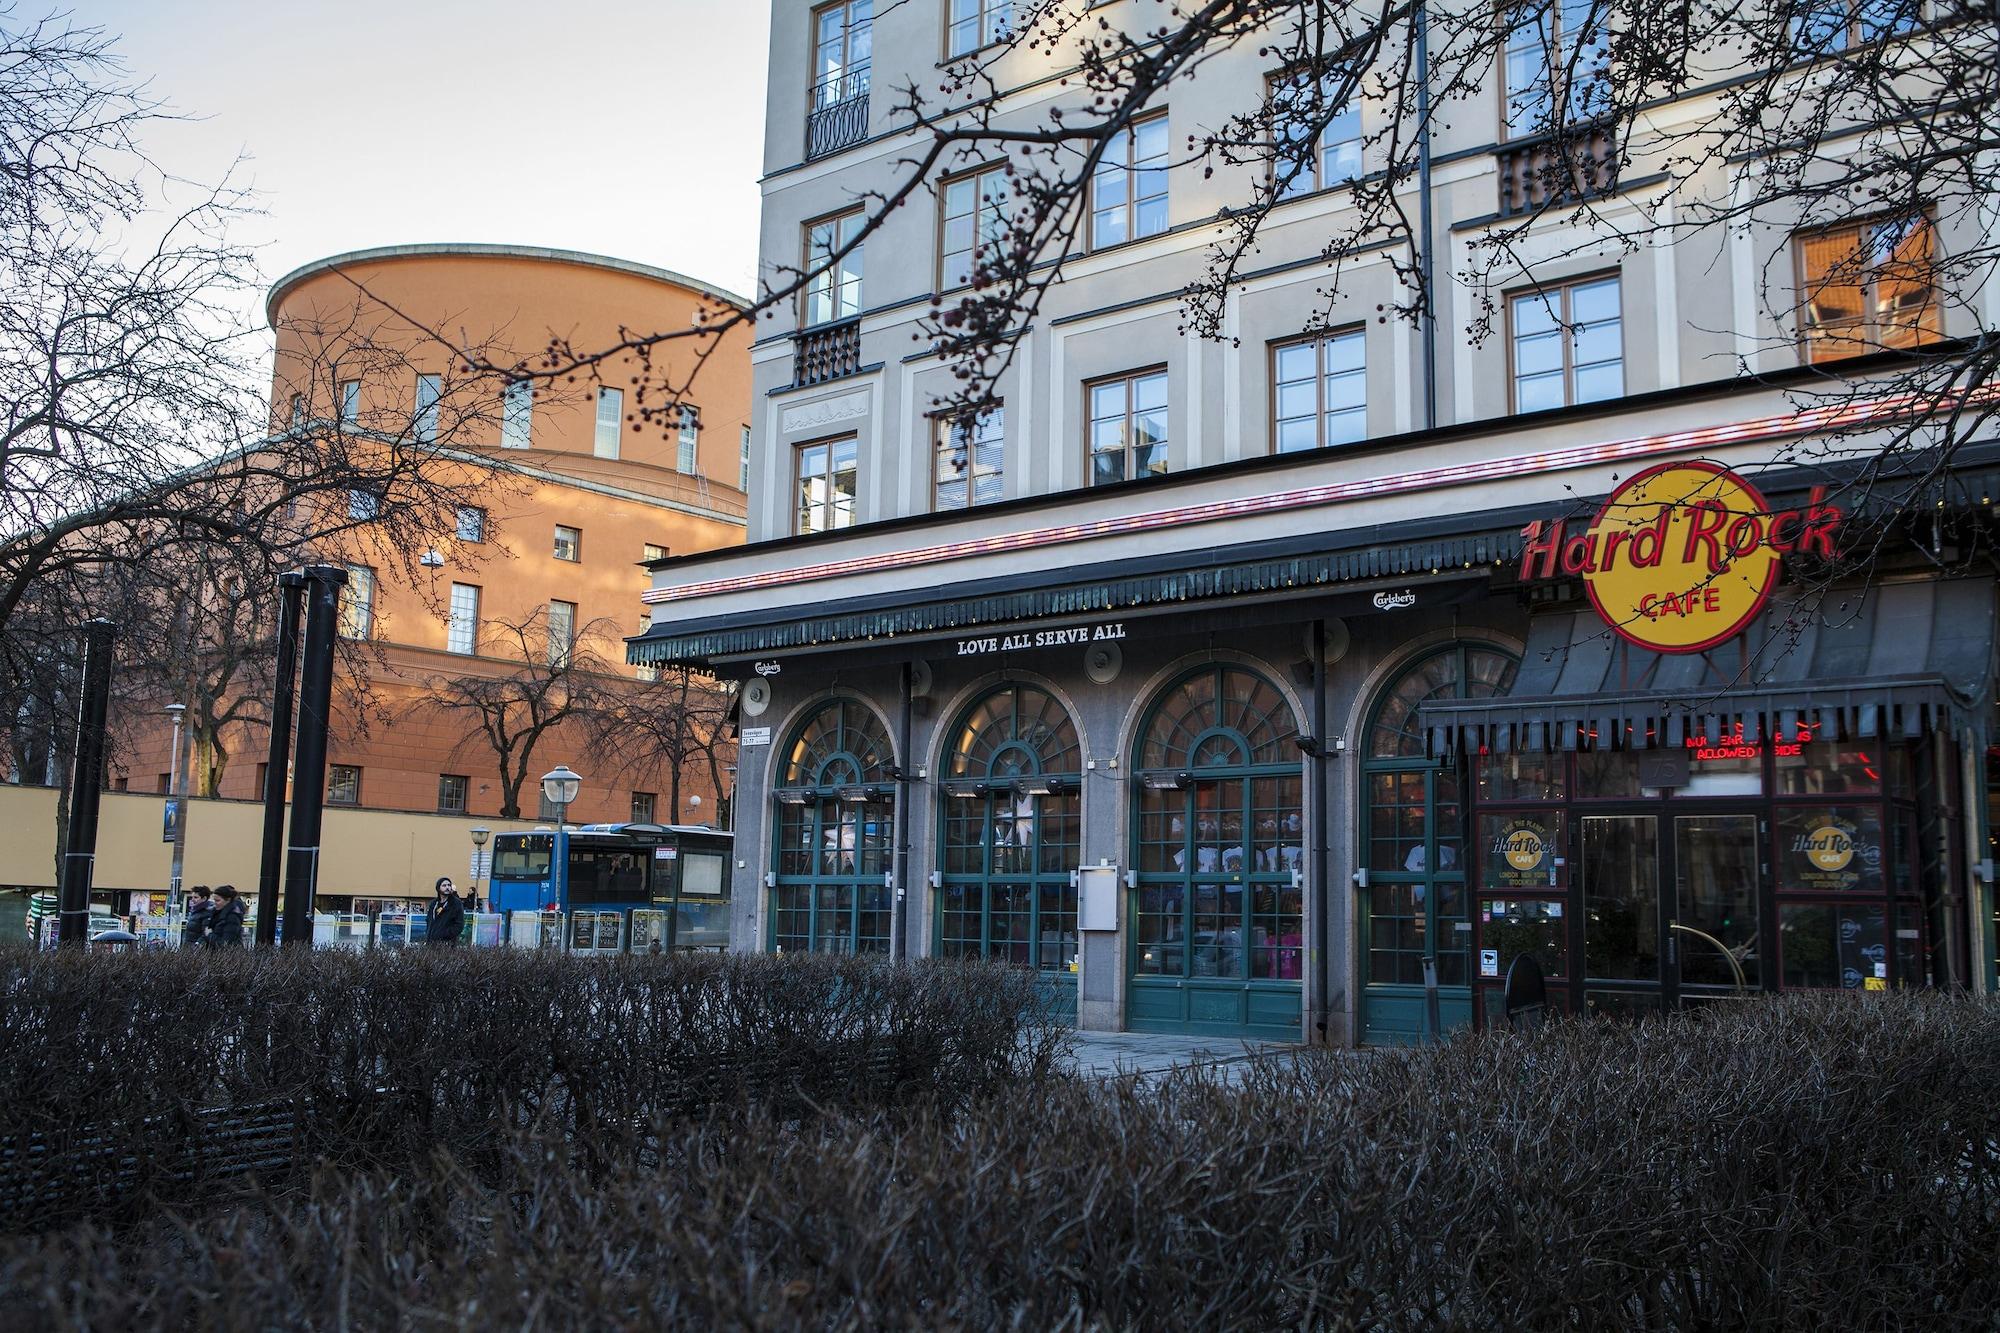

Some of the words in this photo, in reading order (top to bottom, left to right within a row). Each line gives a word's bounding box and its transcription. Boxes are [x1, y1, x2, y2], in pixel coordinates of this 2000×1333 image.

[1518, 504, 1672, 581] Hard
[1681, 485, 1845, 575] Rock
[1373, 590, 1416, 610] Carlsberg
[1639, 587, 1721, 617] CAFE
[957, 638, 998, 655] LOVE
[1001, 634, 1031, 650] ALL
[1035, 627, 1089, 646] SERVE
[1093, 623, 1126, 641] ALL
[754, 660, 781, 676] Carlsberg
[1697, 747, 1756, 760] ALLOWED
[519, 838, 527, 848] 2
[1492, 837, 1523, 853] Hard
[1524, 837, 1557, 856] Rock
[1791, 834, 1829, 851] Hard
[1831, 834, 1868, 856] Rock
[1515, 855, 1534, 863] CAFE
